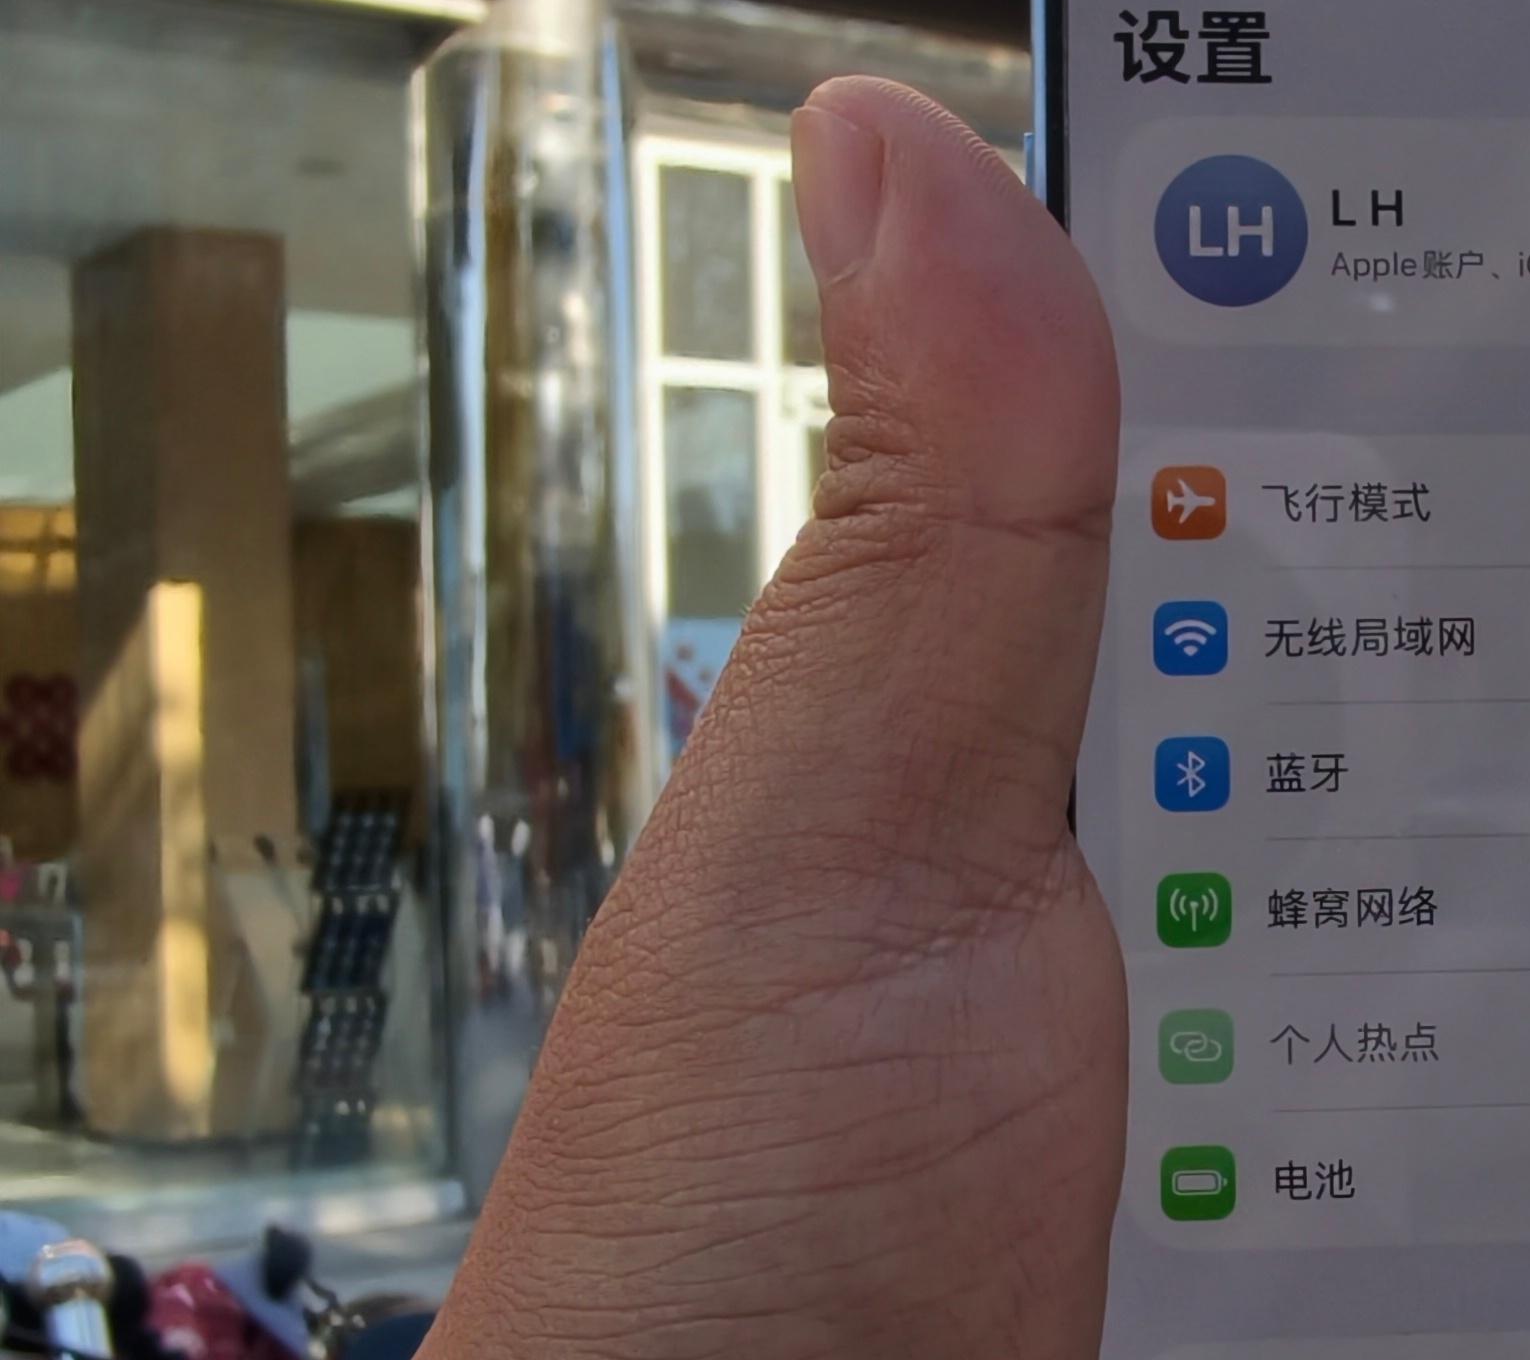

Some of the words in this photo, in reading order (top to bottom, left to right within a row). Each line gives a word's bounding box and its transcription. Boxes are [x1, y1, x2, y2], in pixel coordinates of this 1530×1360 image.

[1113, 9, 1273, 85] 设置
[1188, 204, 1274, 257] LH
[1261, 481, 1432, 523] 飞行模式
[1264, 615, 1477, 658] 无线局域网
[1265, 752, 1349, 794] 蓝牙
[1267, 885, 1438, 929] 蜂窝网络
[1269, 1021, 1440, 1066] 个人热点
[1274, 1158, 1356, 1201] 电池
